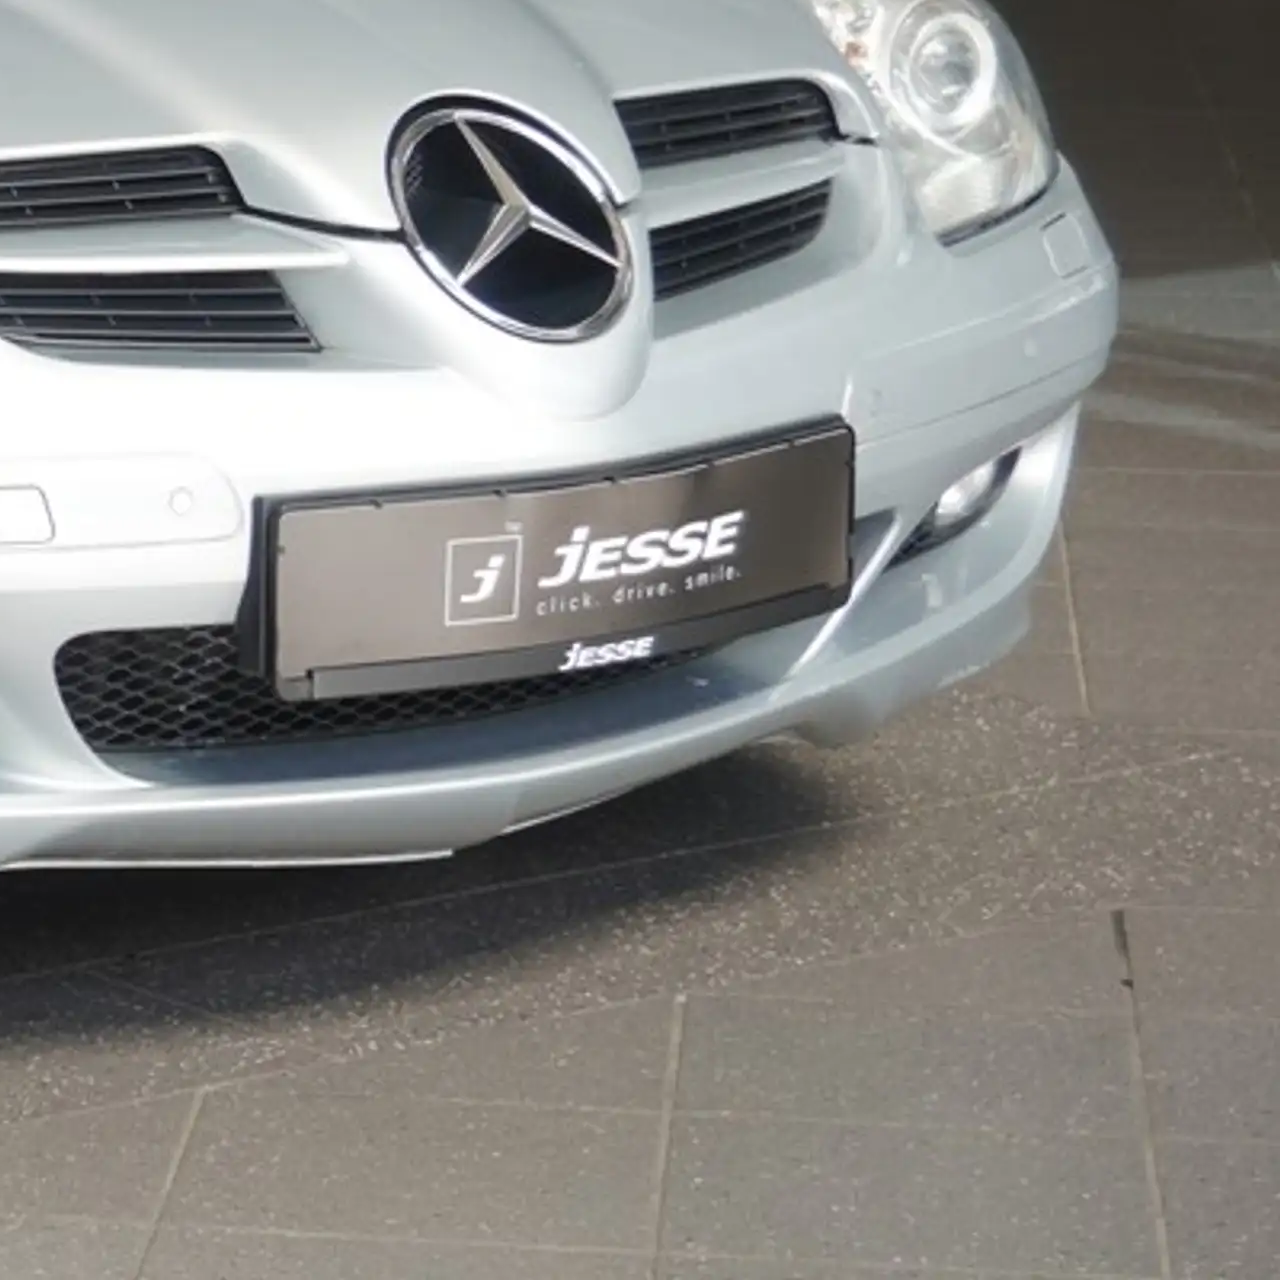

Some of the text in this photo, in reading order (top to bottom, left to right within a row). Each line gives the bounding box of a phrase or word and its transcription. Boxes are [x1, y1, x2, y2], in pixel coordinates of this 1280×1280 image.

[536, 563, 742, 616] click. drive. smile.
